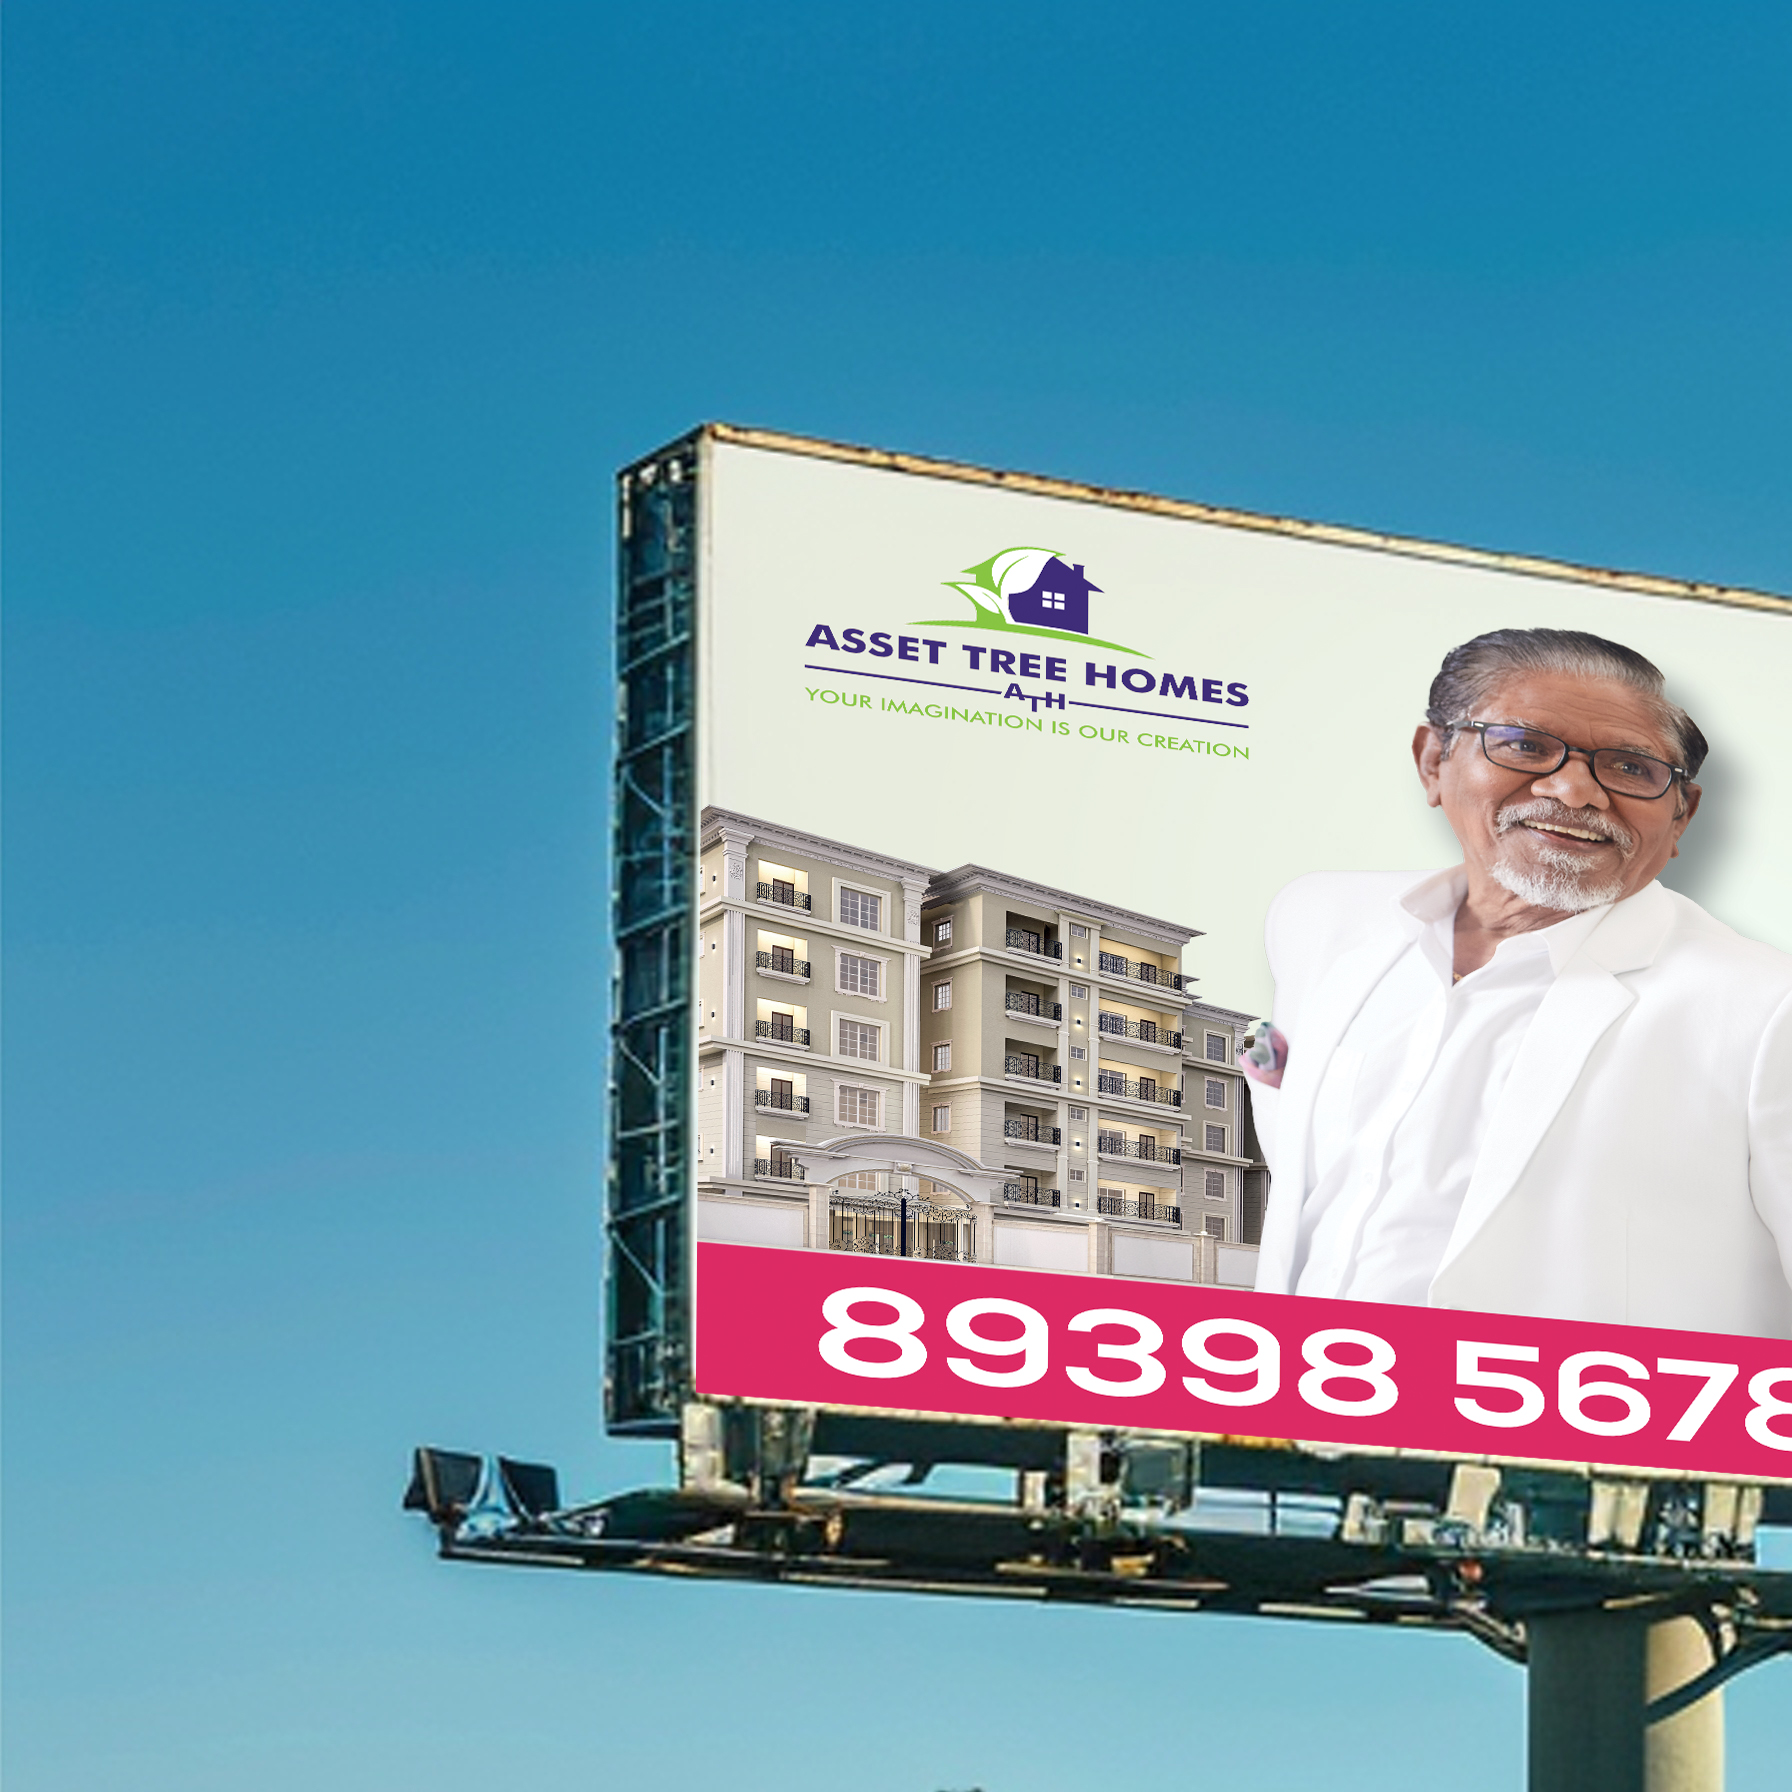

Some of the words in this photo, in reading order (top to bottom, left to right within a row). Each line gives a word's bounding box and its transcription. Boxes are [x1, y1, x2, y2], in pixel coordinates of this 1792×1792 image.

[805, 624, 947, 665] ASSET
[962, 644, 1067, 683] TREE
[1086, 662, 1250, 707] HOMES
[1004, 682, 1066, 713] ATH
[805, 687, 872, 709] YOUR
[882, 697, 1042, 732] IMAGINATION
[1052, 720, 1070, 735] IS
[1079, 725, 1129, 744] OUR
[1137, 733, 1249, 760] CREATION
[817, 1286, 1400, 1418] 89398
